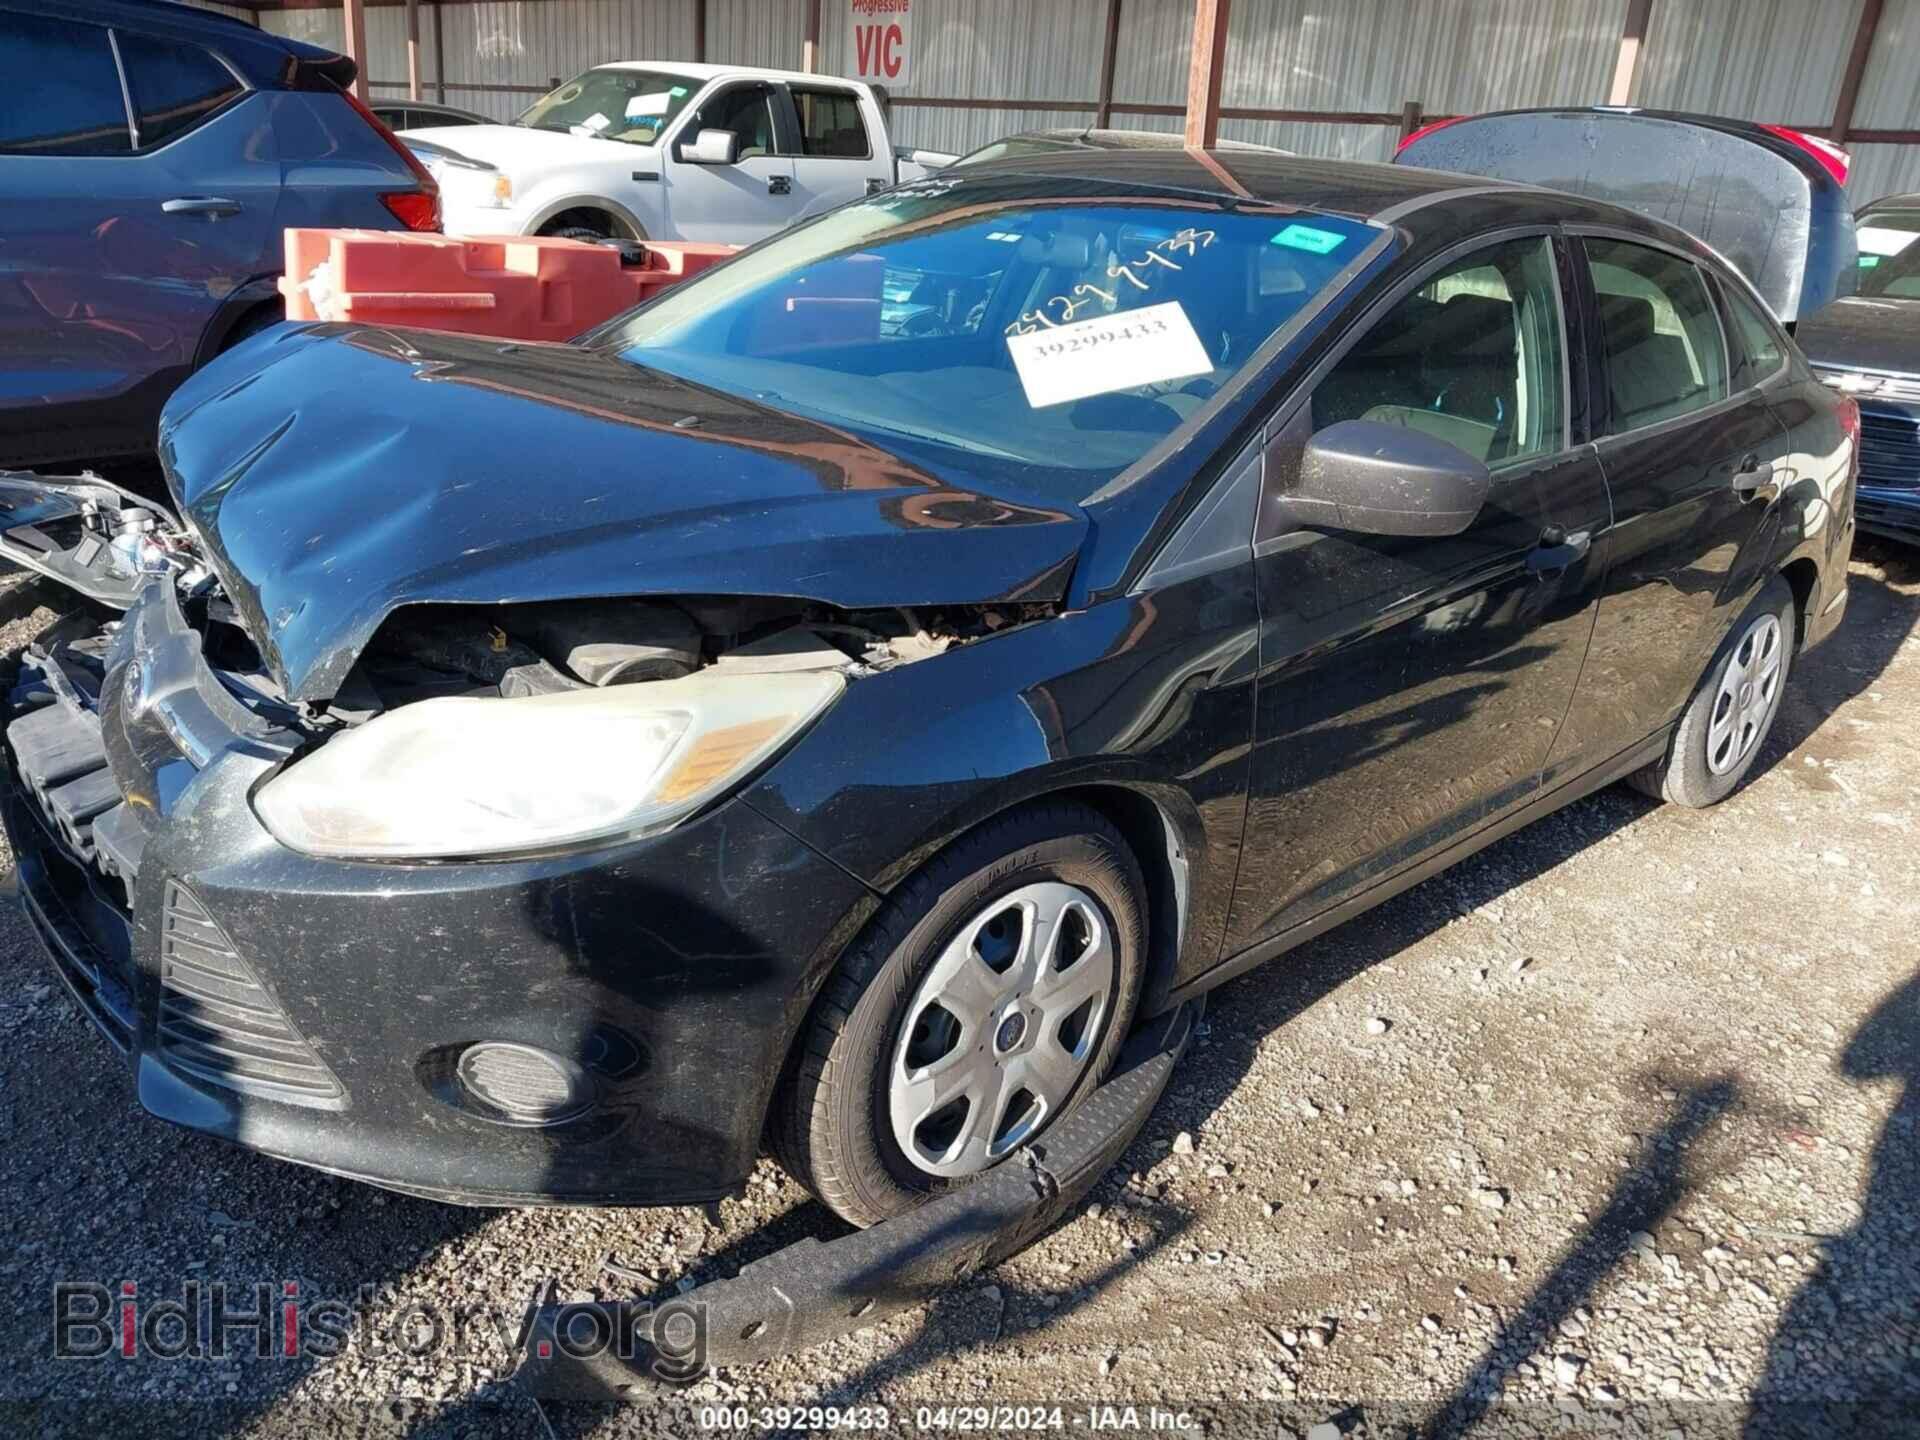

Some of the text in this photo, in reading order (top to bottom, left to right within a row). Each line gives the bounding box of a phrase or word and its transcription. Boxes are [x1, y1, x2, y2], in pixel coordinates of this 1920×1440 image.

[852, 0, 908, 16] Progressive
[856, 24, 902, 78] VIC
[1033, 319, 1168, 360] 39299433
